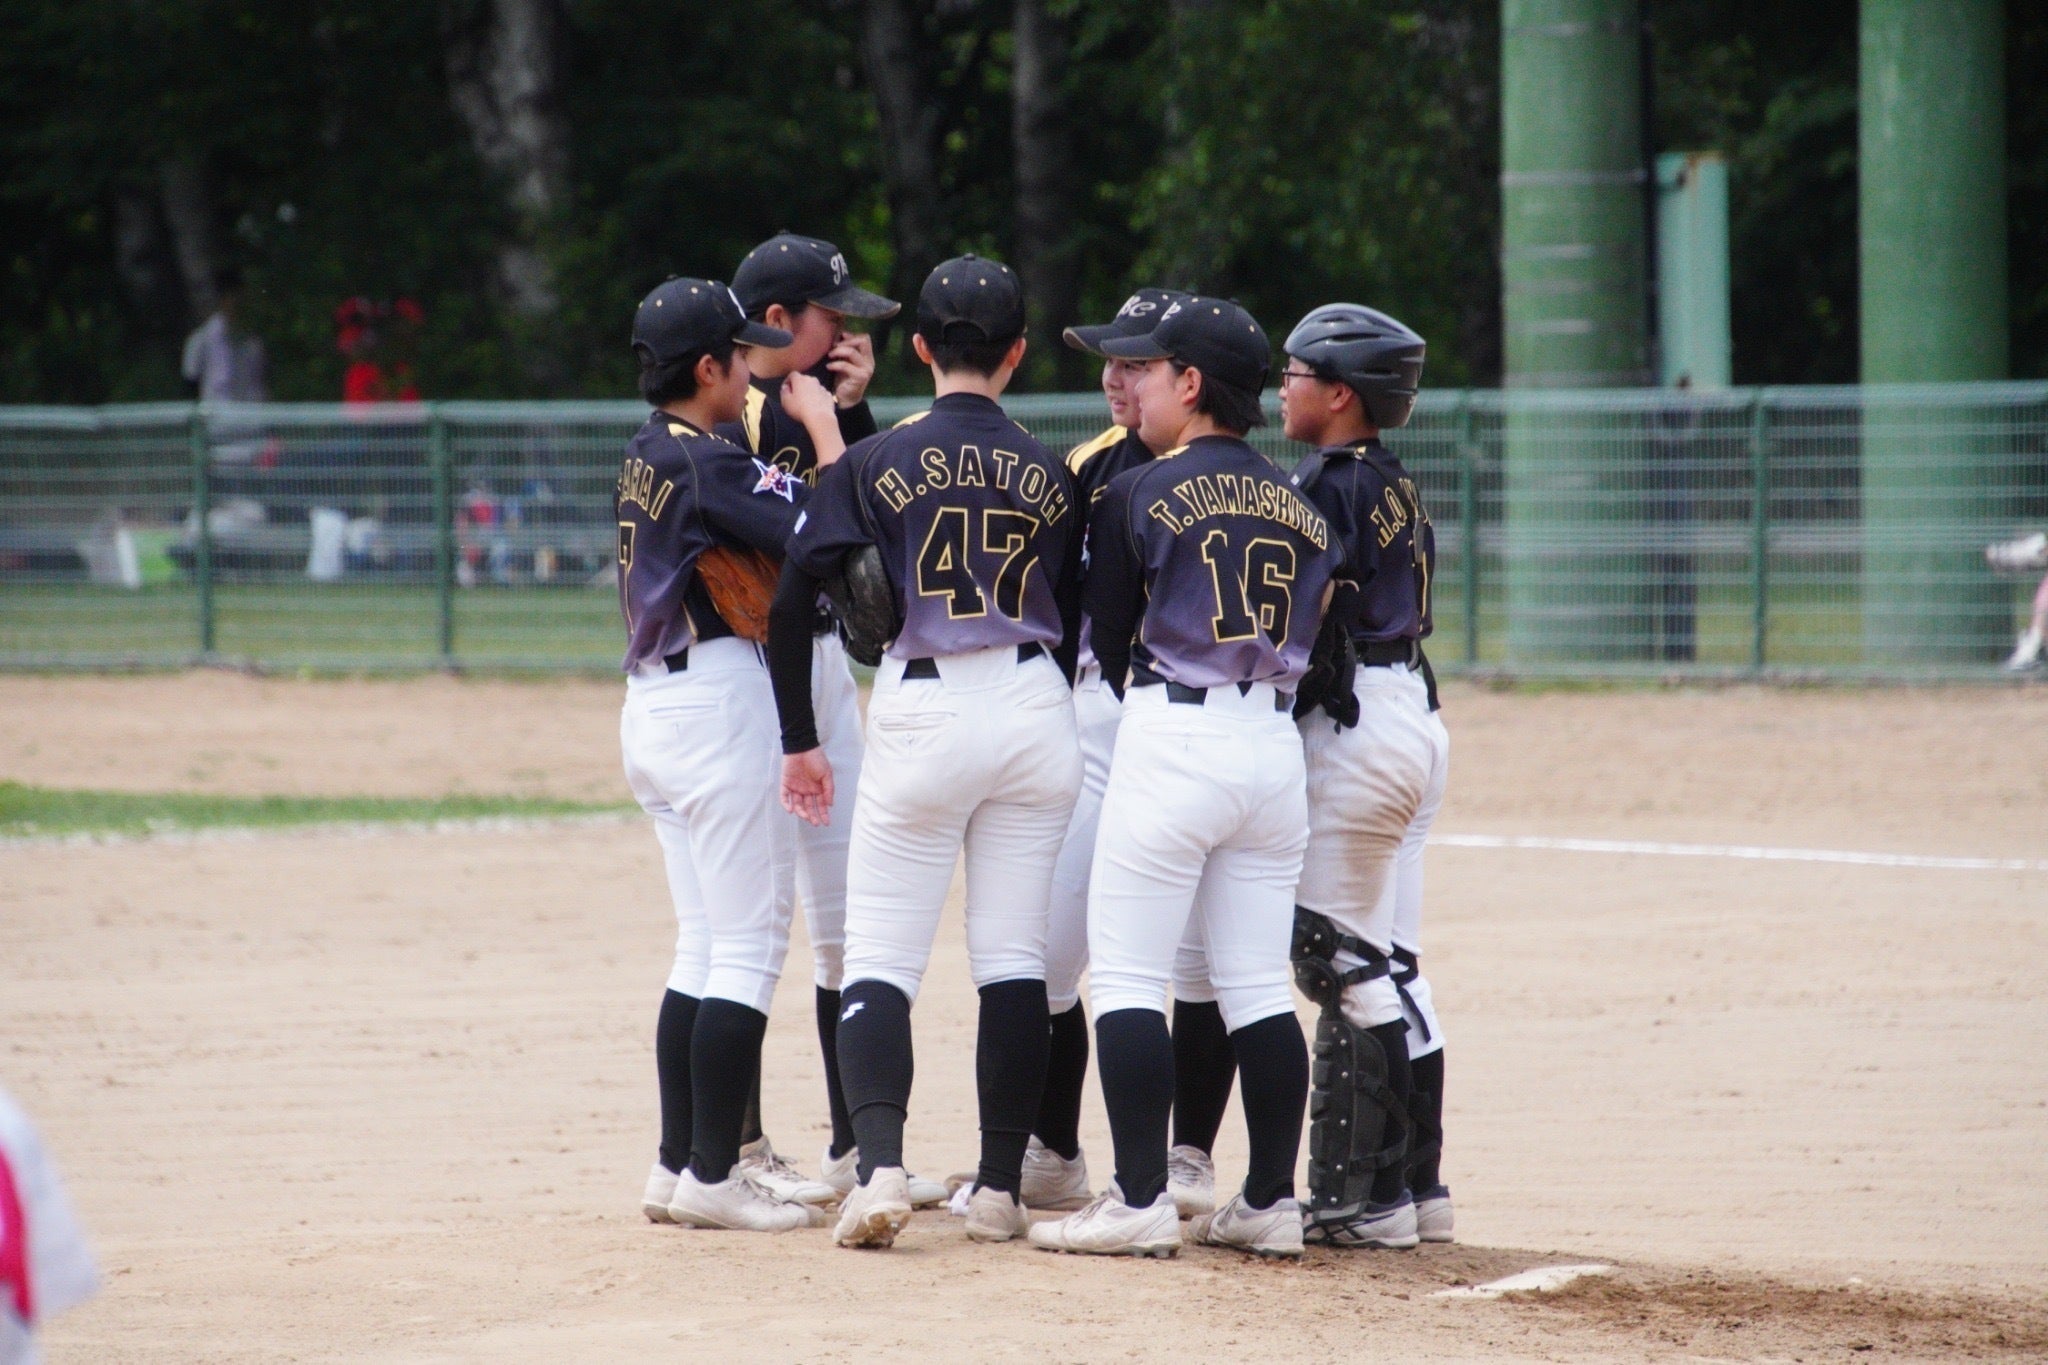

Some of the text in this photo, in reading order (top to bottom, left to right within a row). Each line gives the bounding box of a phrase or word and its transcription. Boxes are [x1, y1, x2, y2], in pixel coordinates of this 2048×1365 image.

[875, 445, 1068, 526] H.SATOH
[1148, 474, 1328, 550] T.YAMASHITA
[916, 506, 1041, 622] 47
[1201, 530, 1297, 652] 16
